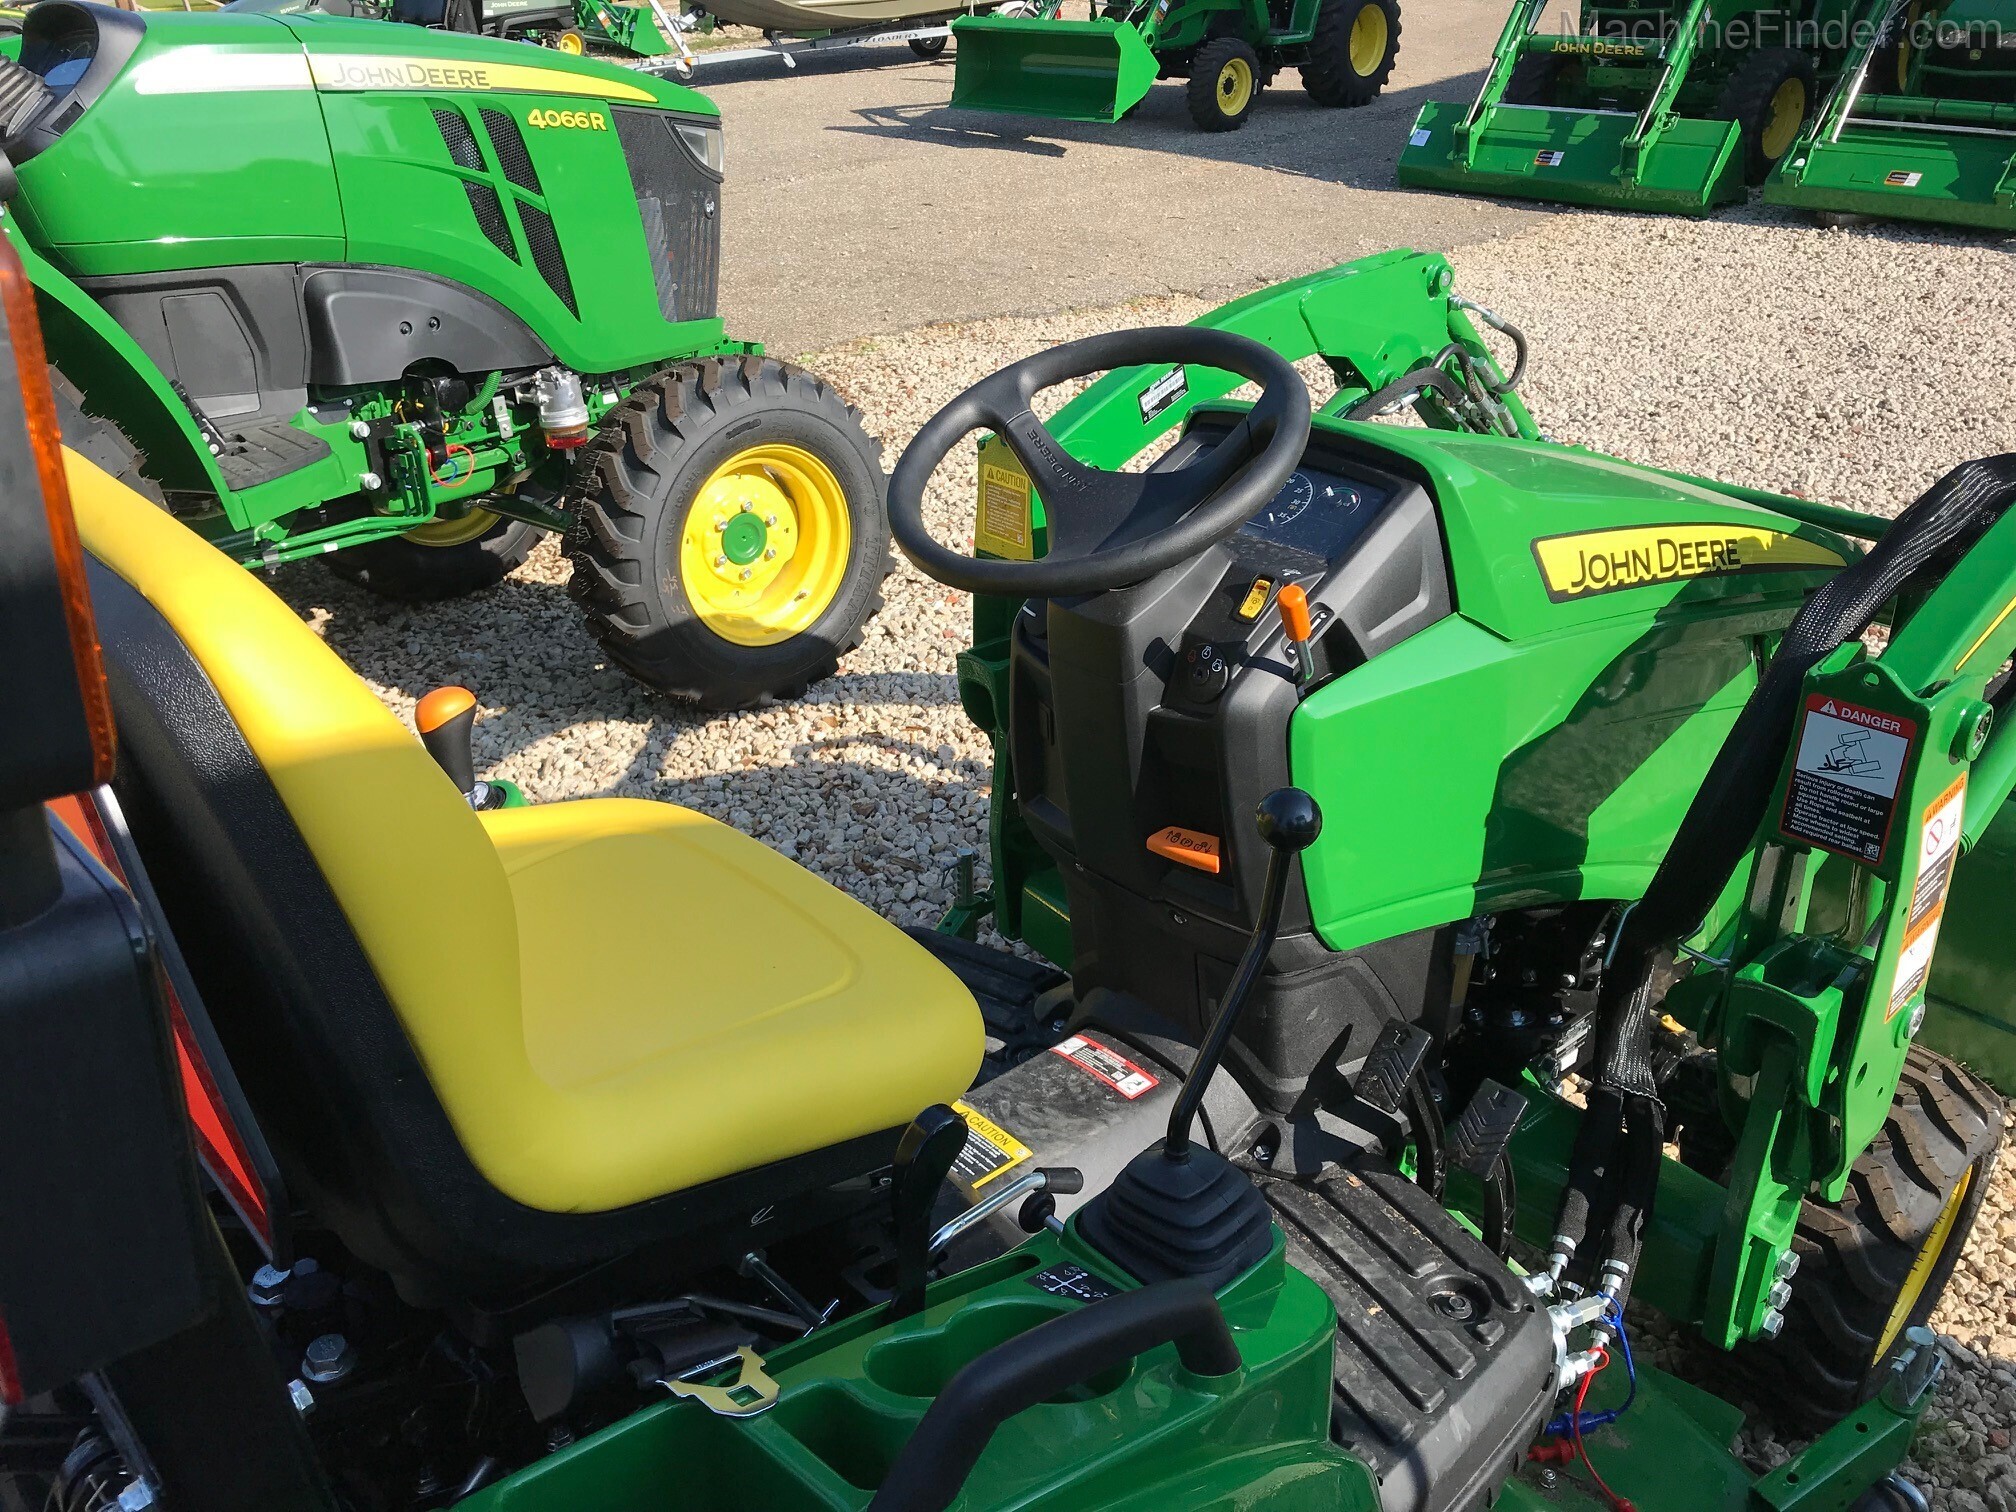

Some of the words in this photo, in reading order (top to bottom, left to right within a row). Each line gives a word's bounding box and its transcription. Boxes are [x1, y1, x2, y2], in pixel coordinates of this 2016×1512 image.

[1551, 40, 1590, 53] JOHN
[1593, 42, 1645, 56] DEERE
[333, 62, 403, 86] JOHN
[405, 63, 490, 87] DEERE
[527, 108, 608, 131] 4066R
[1026, 428, 1063, 473] DEERE
[995, 469, 1026, 490] CAUTION
[1571, 547, 1652, 588] JOHN
[1656, 538, 1741, 573] DEERE
[843, 536, 880, 622] TITAN
[1841, 706, 1901, 733] DANGER
[1794, 777, 1811, 786] result
[1812, 783, 1826, 791] from
[1827, 788, 1855, 800] rollovers.
[1795, 771, 1818, 782] Serious
[1818, 779, 1835, 788] injury
[1844, 787, 1862, 796] death
[1932, 777, 1964, 815] WARNING
[1798, 791, 1817, 801] square
[1818, 797, 1836, 807] bales.
[1803, 804, 1821, 814] times.
[1819, 791, 1840, 802] handle
[1840, 798, 1858, 807] round
[1867, 806, 1883, 816] large
[1792, 812, 1809, 821] Move
[1809, 818, 1830, 829] wheels
[1838, 828, 1859, 838] widest
[1793, 807, 1817, 819] Operate
[1818, 815, 1838, 825] tractor
[1858, 828, 1879, 839] speed.
[1837, 809, 1862, 821] seatbelt
[1790, 819, 1833, 836] recommended
[1833, 833, 1856, 844] setting.
[1802, 828, 1827, 840] required
[969, 1115, 1011, 1146] CAUTION
